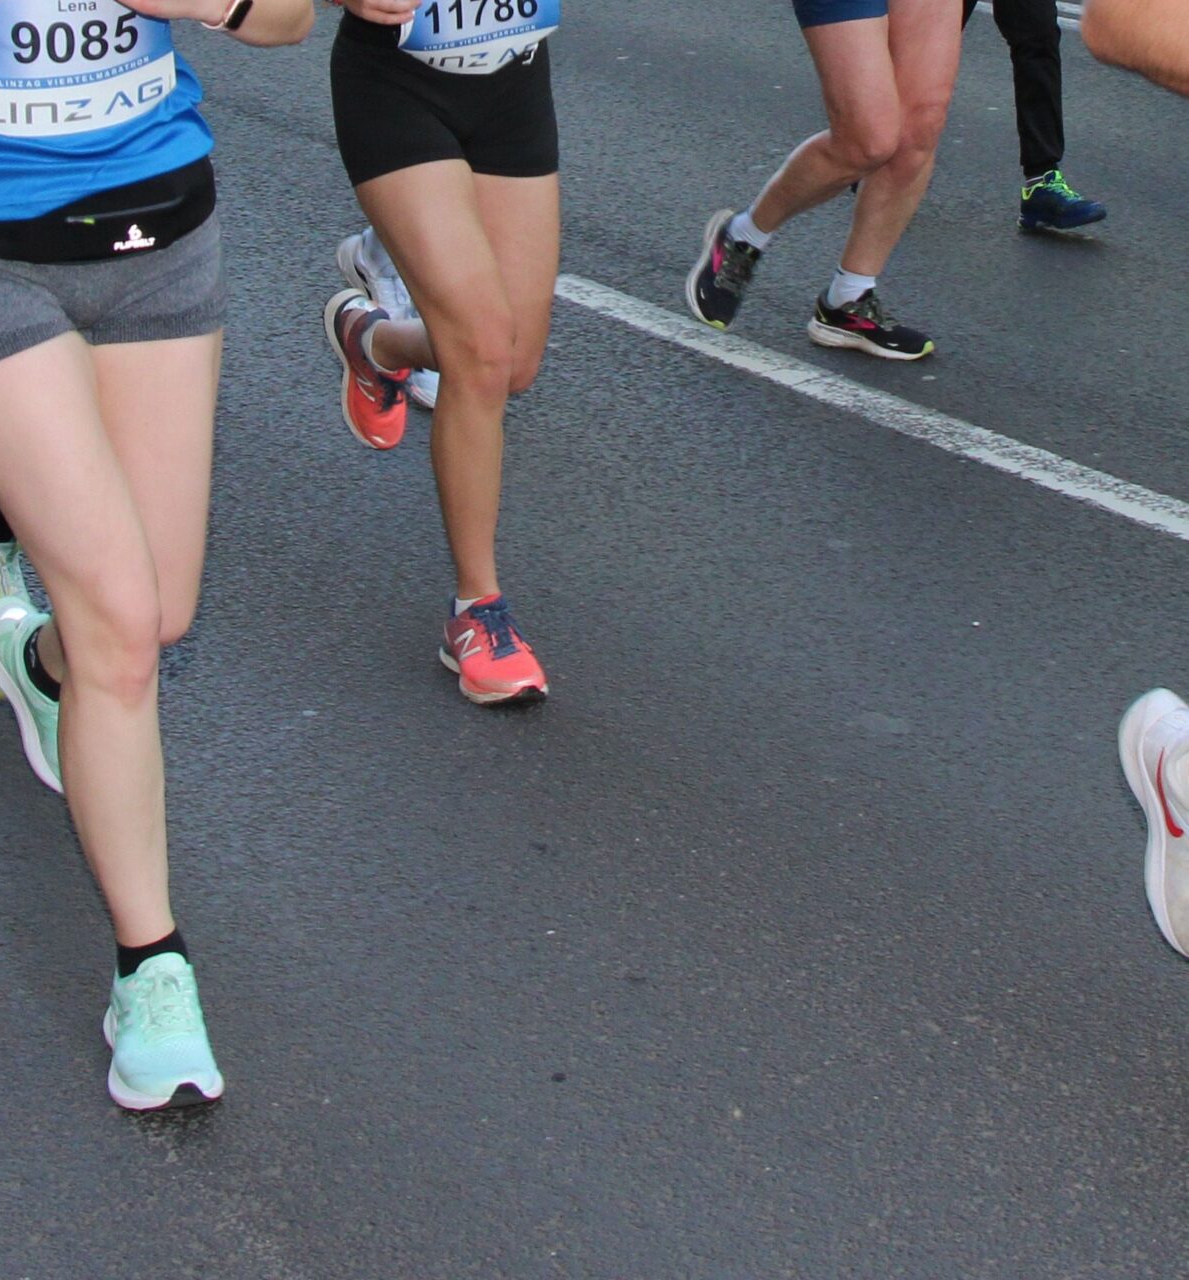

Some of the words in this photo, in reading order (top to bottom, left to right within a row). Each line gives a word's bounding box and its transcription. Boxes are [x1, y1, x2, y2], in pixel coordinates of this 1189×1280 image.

[58, 0, 97, 13] Lena
[11, 10, 139, 64] 9085
[47, 56, 150, 86] VIERTELMARATHON
[105, 77, 164, 115] AG
